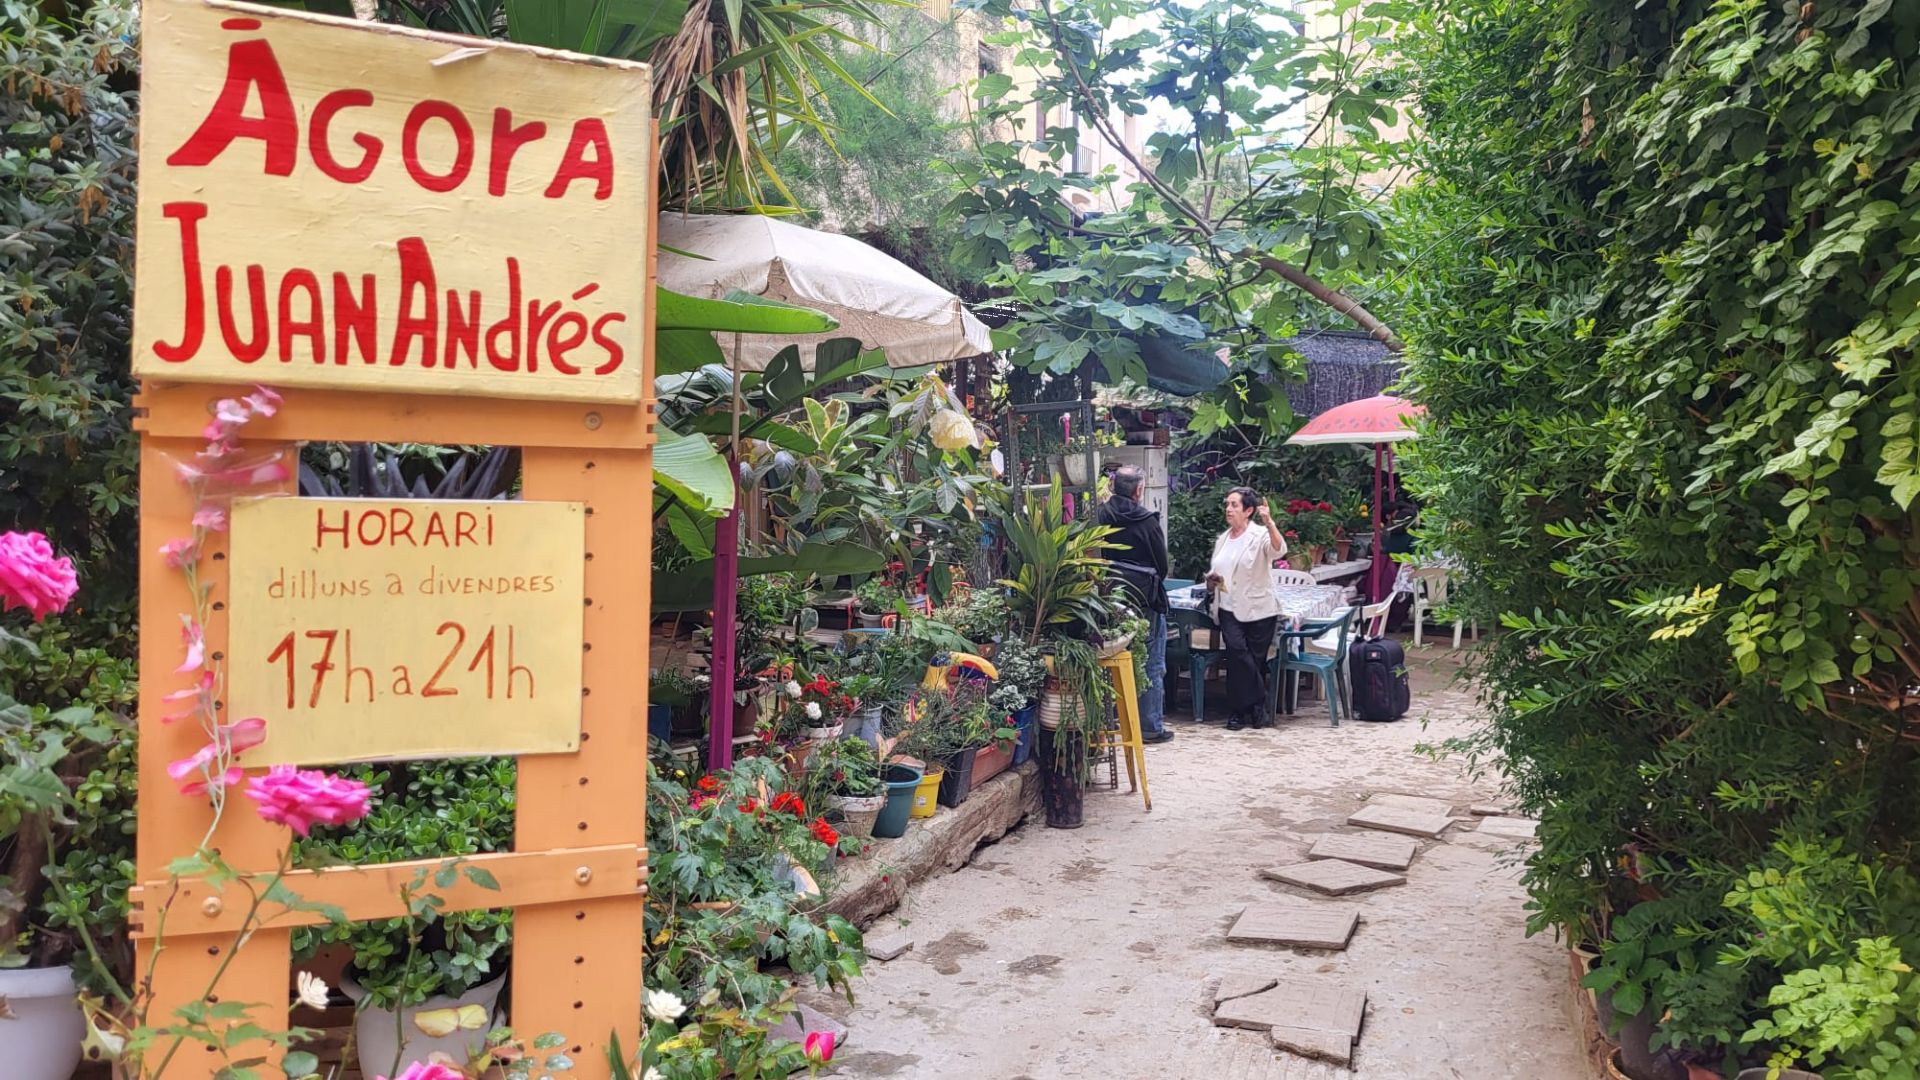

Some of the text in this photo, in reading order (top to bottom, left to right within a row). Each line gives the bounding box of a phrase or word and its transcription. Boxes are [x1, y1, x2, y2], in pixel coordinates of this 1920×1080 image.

[152, 201, 378, 366] JUAN
[384, 572, 405, 597] a
[266, 620, 536, 711] 17h a 21h
